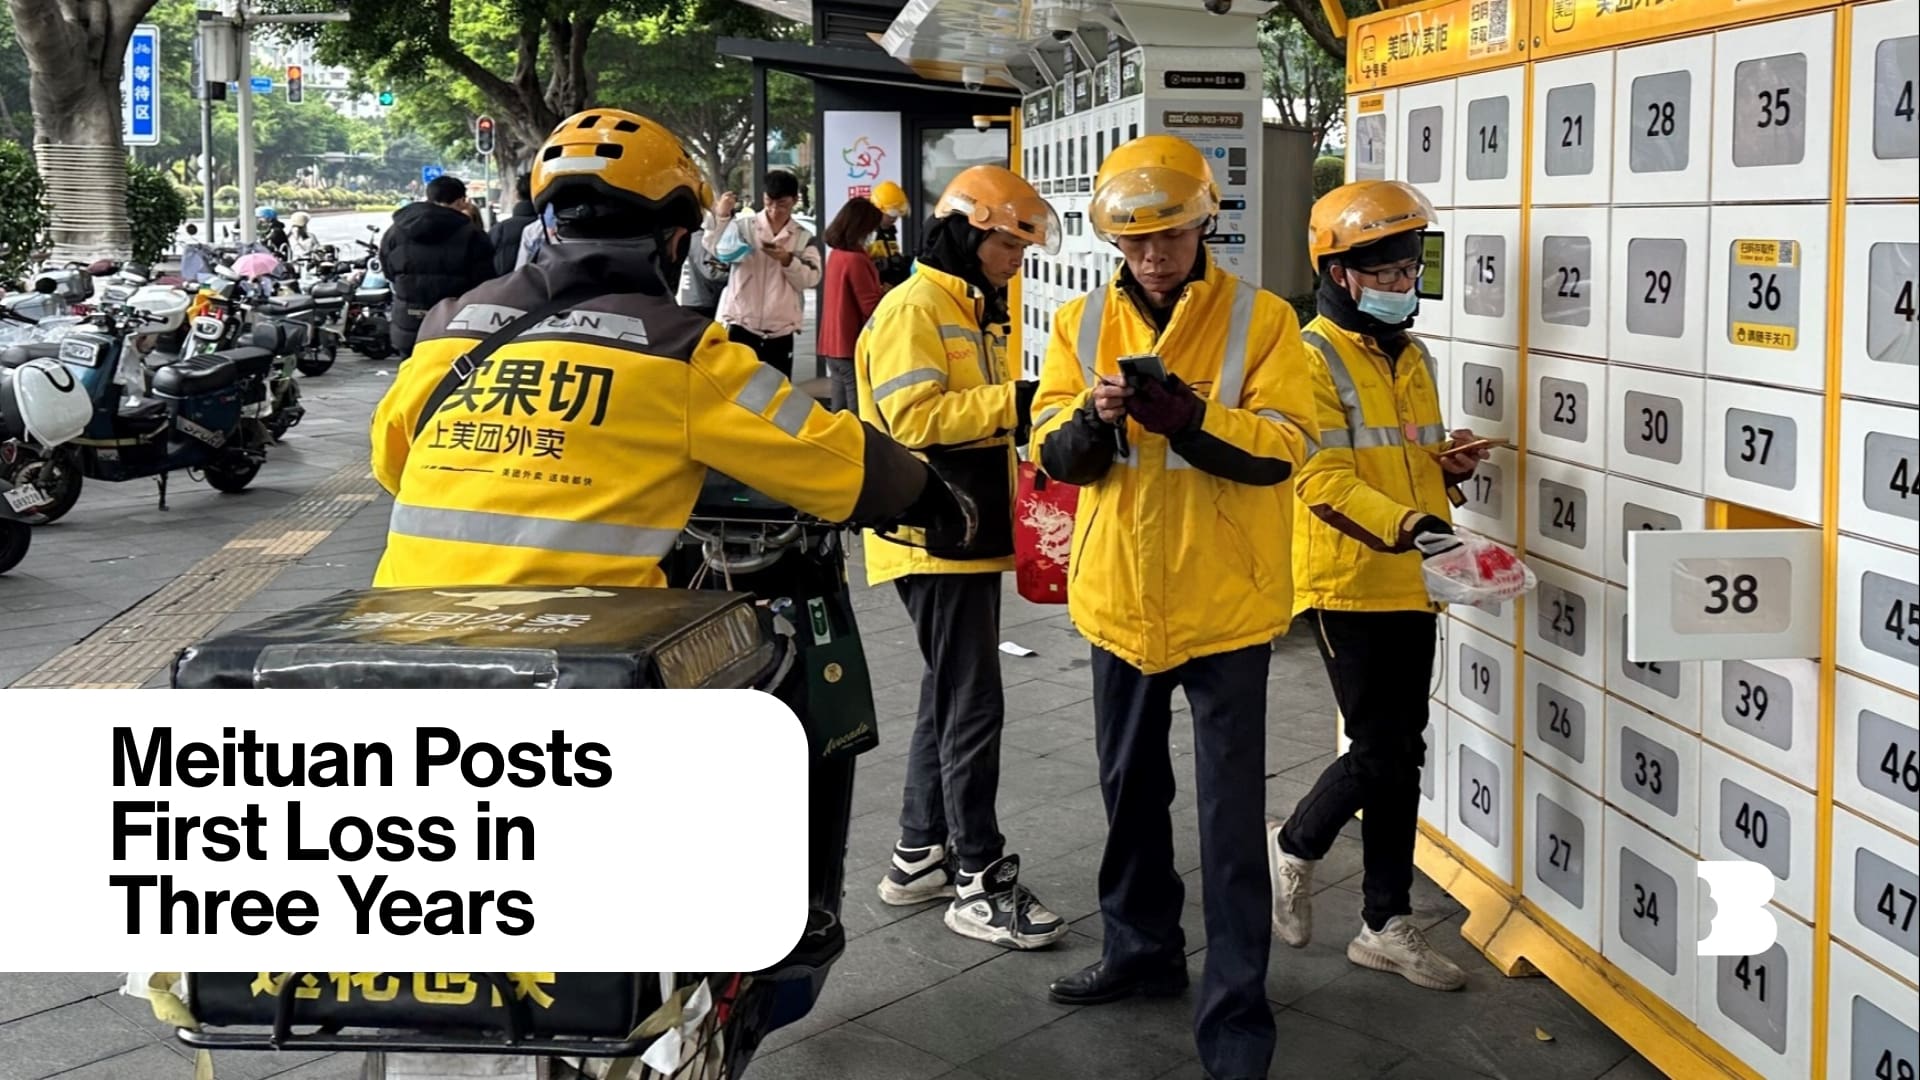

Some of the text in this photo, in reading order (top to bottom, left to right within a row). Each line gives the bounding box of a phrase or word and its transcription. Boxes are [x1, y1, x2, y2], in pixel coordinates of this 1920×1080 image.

[1387, 23, 1448, 62] 美团外卖柜
[134, 65, 150, 120] 等待区
[1757, 87, 1791, 129] 35
[1561, 114, 1583, 148] 21
[1646, 101, 1675, 137] 28
[1422, 125, 1431, 153] 8
[1479, 125, 1498, 154] 14
[1476, 255, 1496, 285] 15
[1557, 266, 1581, 299] 22
[1644, 270, 1672, 305] 29
[1747, 272, 1781, 312] 36
[1475, 376, 1496, 407] 16
[1553, 391, 1577, 425] 23
[428, 420, 566, 459] 上美团外卖
[1641, 407, 1669, 445] 30
[1740, 424, 1774, 466] 37
[501, 468, 543, 481] 美团外卖
[1473, 473, 1492, 505] 17
[1552, 496, 1576, 533] 24
[1704, 574, 1759, 615] 38
[1551, 599, 1575, 637] 25
[1471, 662, 1491, 695] 19
[1548, 700, 1572, 739] 26
[1735, 679, 1769, 722] 39
[1634, 751, 1663, 795] 33
[1880, 742, 1919, 793] 46
[1471, 778, 1491, 815] 20
[1735, 802, 1768, 849] 40
[1549, 833, 1572, 872] 27
[1633, 883, 1660, 927] 34
[1877, 882, 1918, 932] 47
[1734, 955, 1766, 1003] 41
